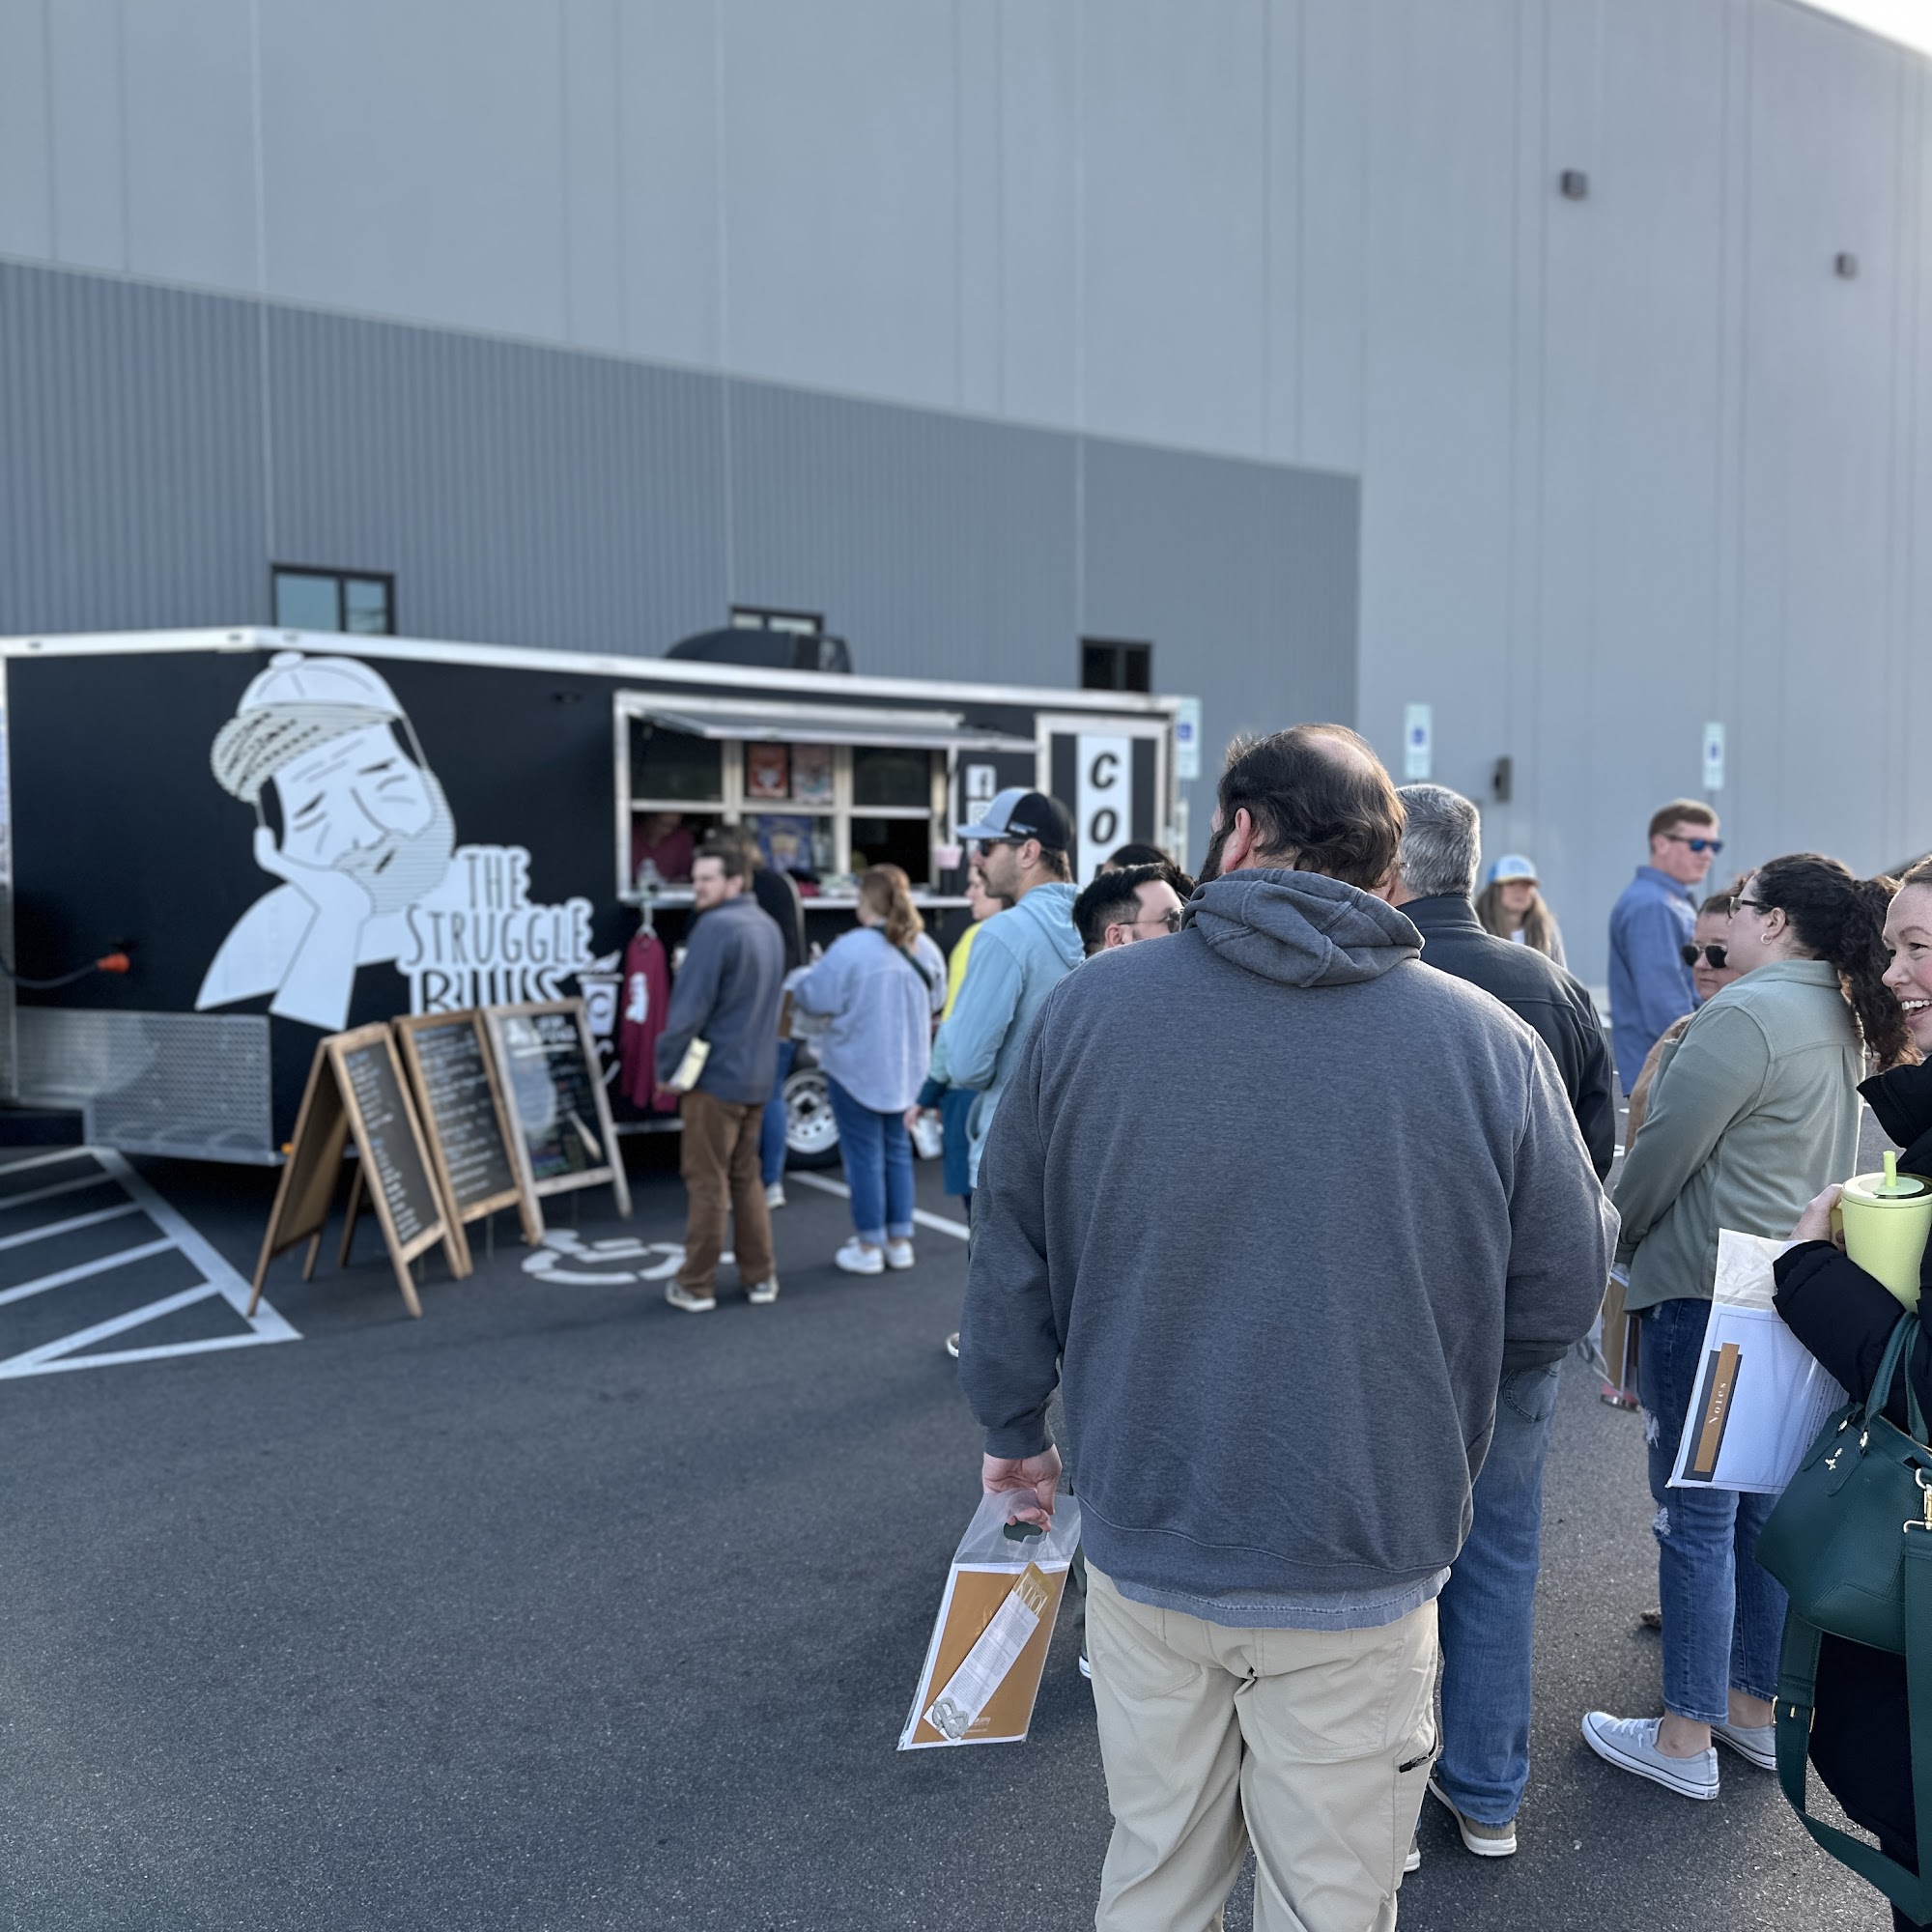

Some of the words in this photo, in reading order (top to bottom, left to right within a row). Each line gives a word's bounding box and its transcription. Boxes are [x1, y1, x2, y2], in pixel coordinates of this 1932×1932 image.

[464, 853, 526, 910] THE
[406, 903, 588, 966] STRUGGLE
[1708, 1382, 1726, 1424] Notes
